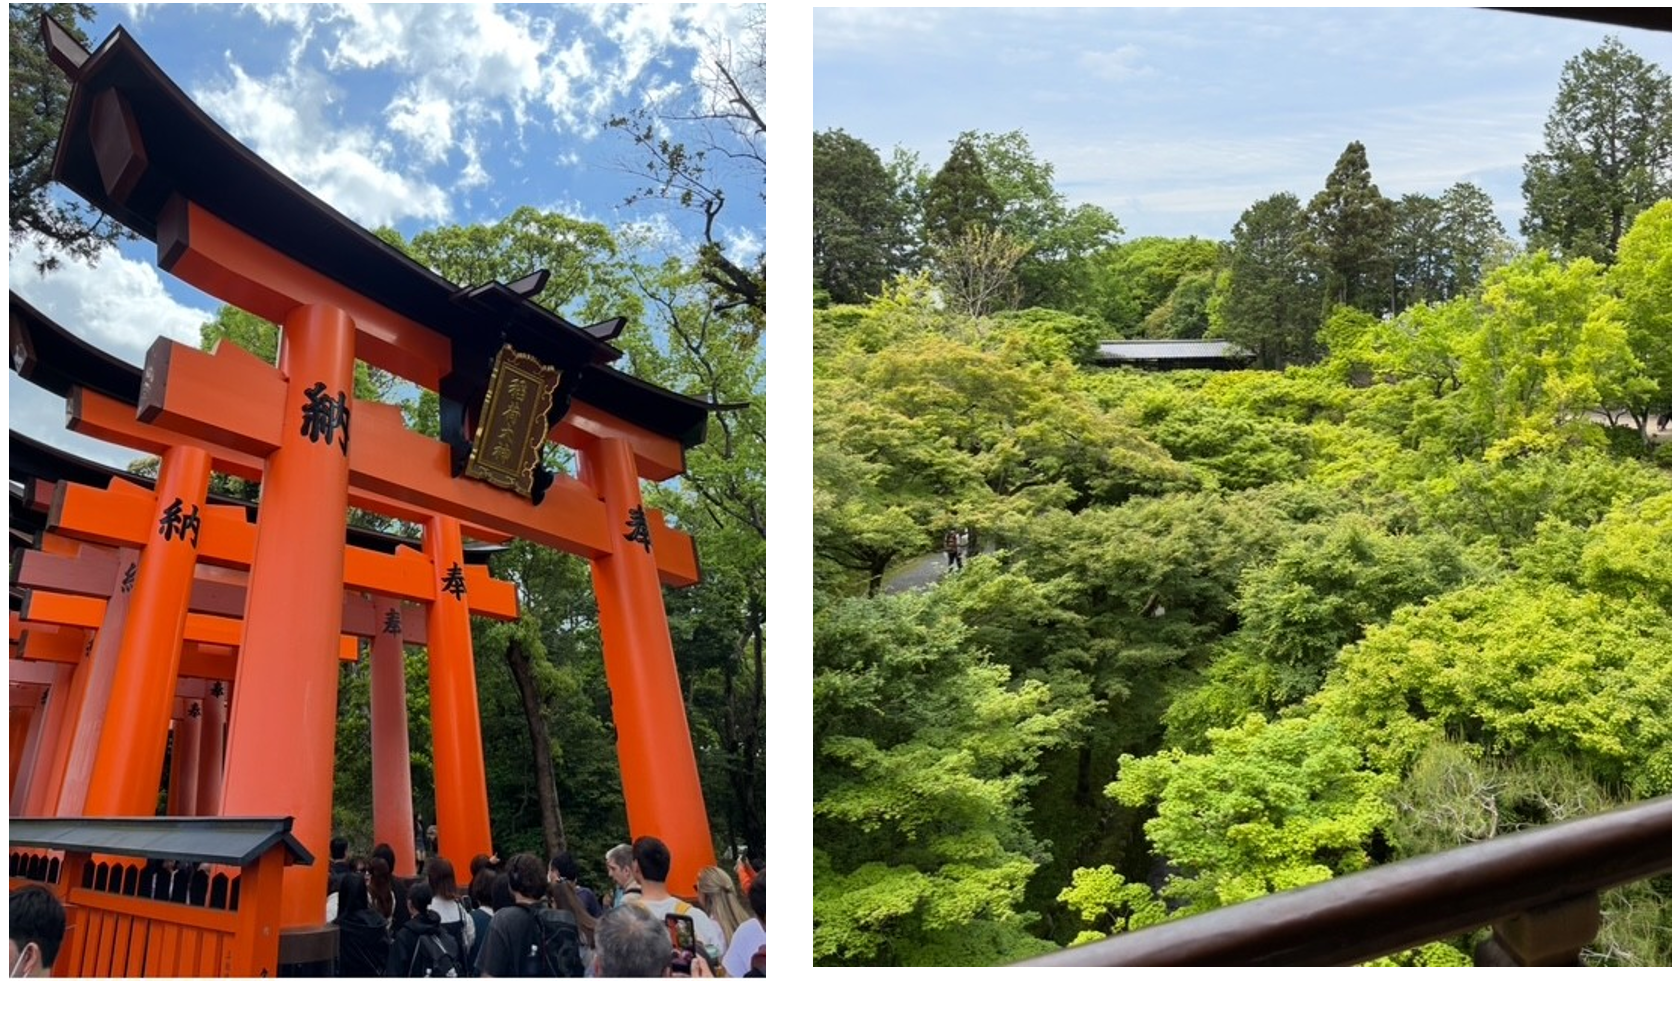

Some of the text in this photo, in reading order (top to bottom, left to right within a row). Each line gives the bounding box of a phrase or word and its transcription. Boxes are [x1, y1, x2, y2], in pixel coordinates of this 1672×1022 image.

[300, 382, 350, 457] 納
[492, 377, 526, 465] 稲荷大神
[159, 498, 201, 549] 納
[623, 504, 651, 554] 奉
[441, 562, 467, 601] 奉
[383, 608, 402, 638] 奉
